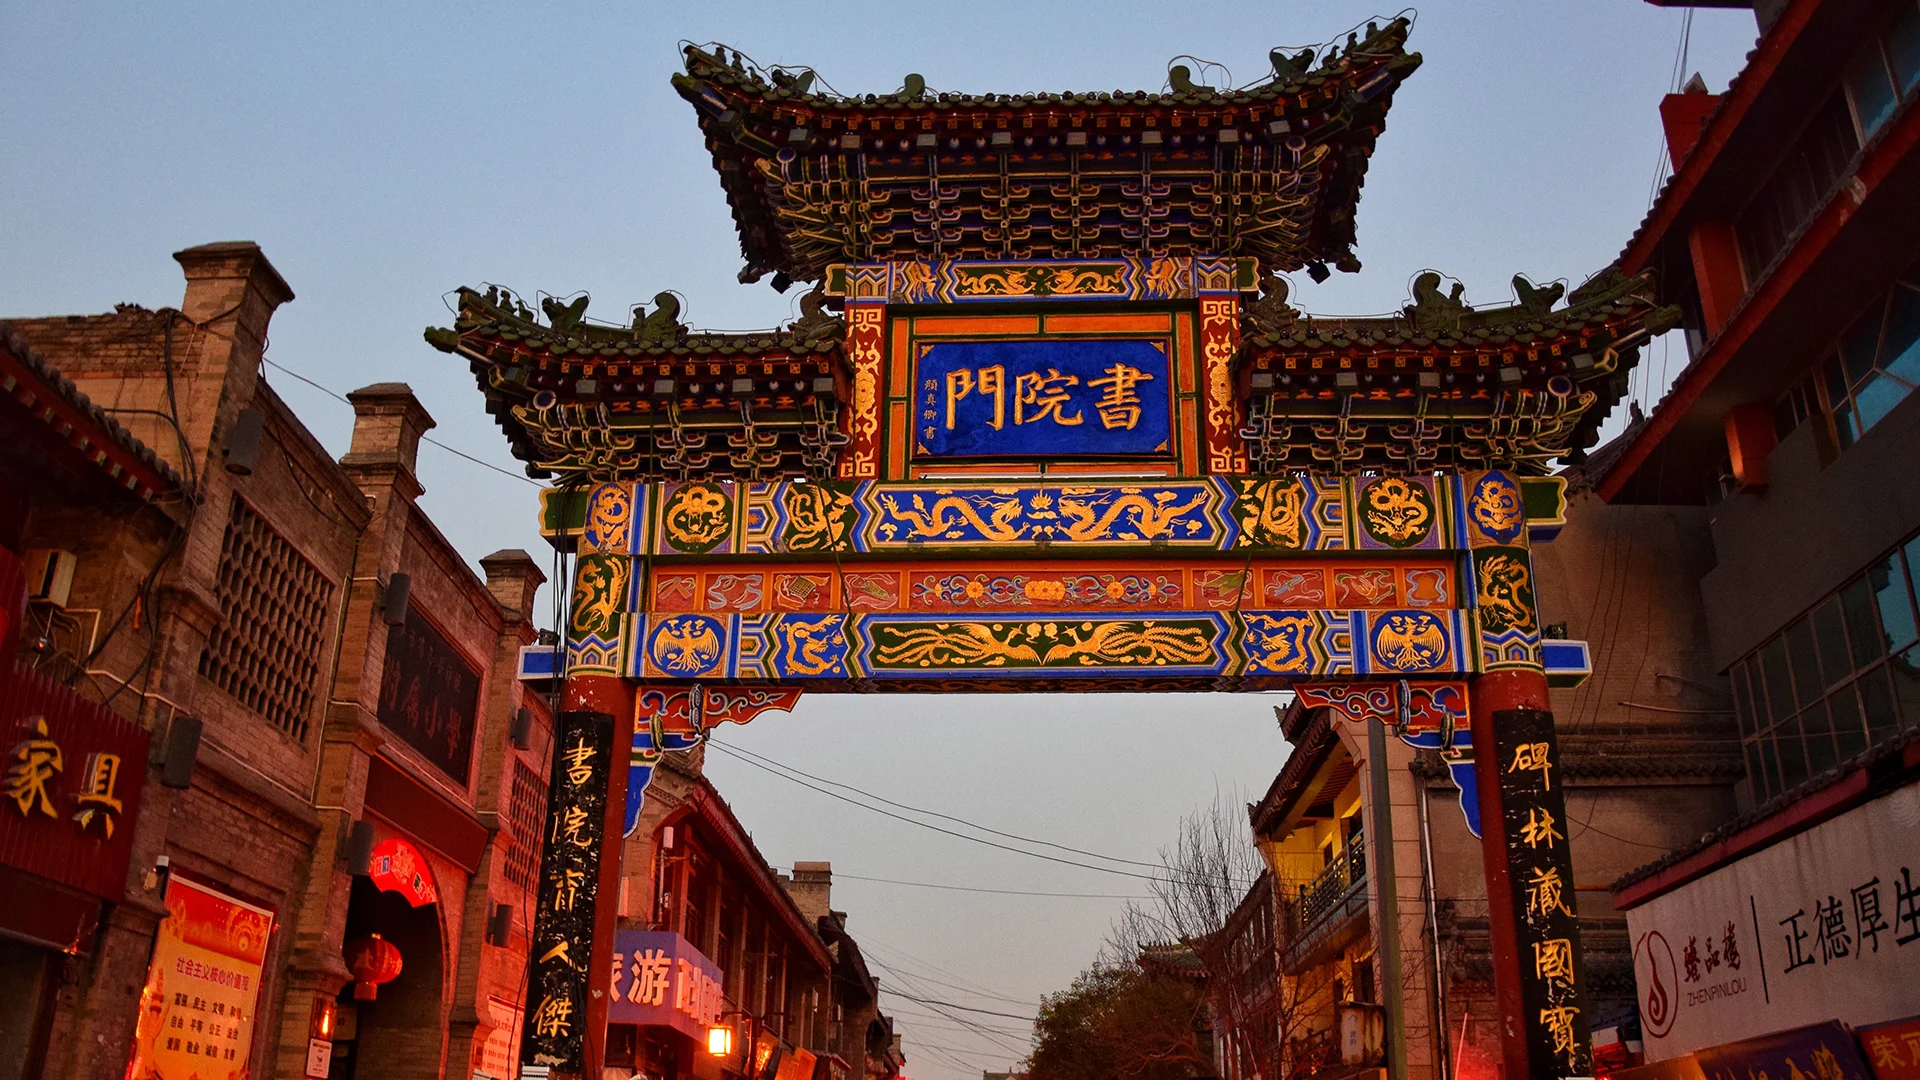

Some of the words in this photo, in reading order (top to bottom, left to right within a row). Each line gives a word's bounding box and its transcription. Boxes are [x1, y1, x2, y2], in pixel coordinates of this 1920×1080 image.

[5, 716, 123, 840] 家具
[1779, 866, 1920, 974] 正德厚生
[177, 956, 249, 991] 社会主义核心价值观
[193, 997, 206, 1011] 民主
[1687, 977, 1747, 1007] ZHENPINLOU
[171, 1015, 184, 1029] 自由
[209, 1023, 220, 1037] 公正
